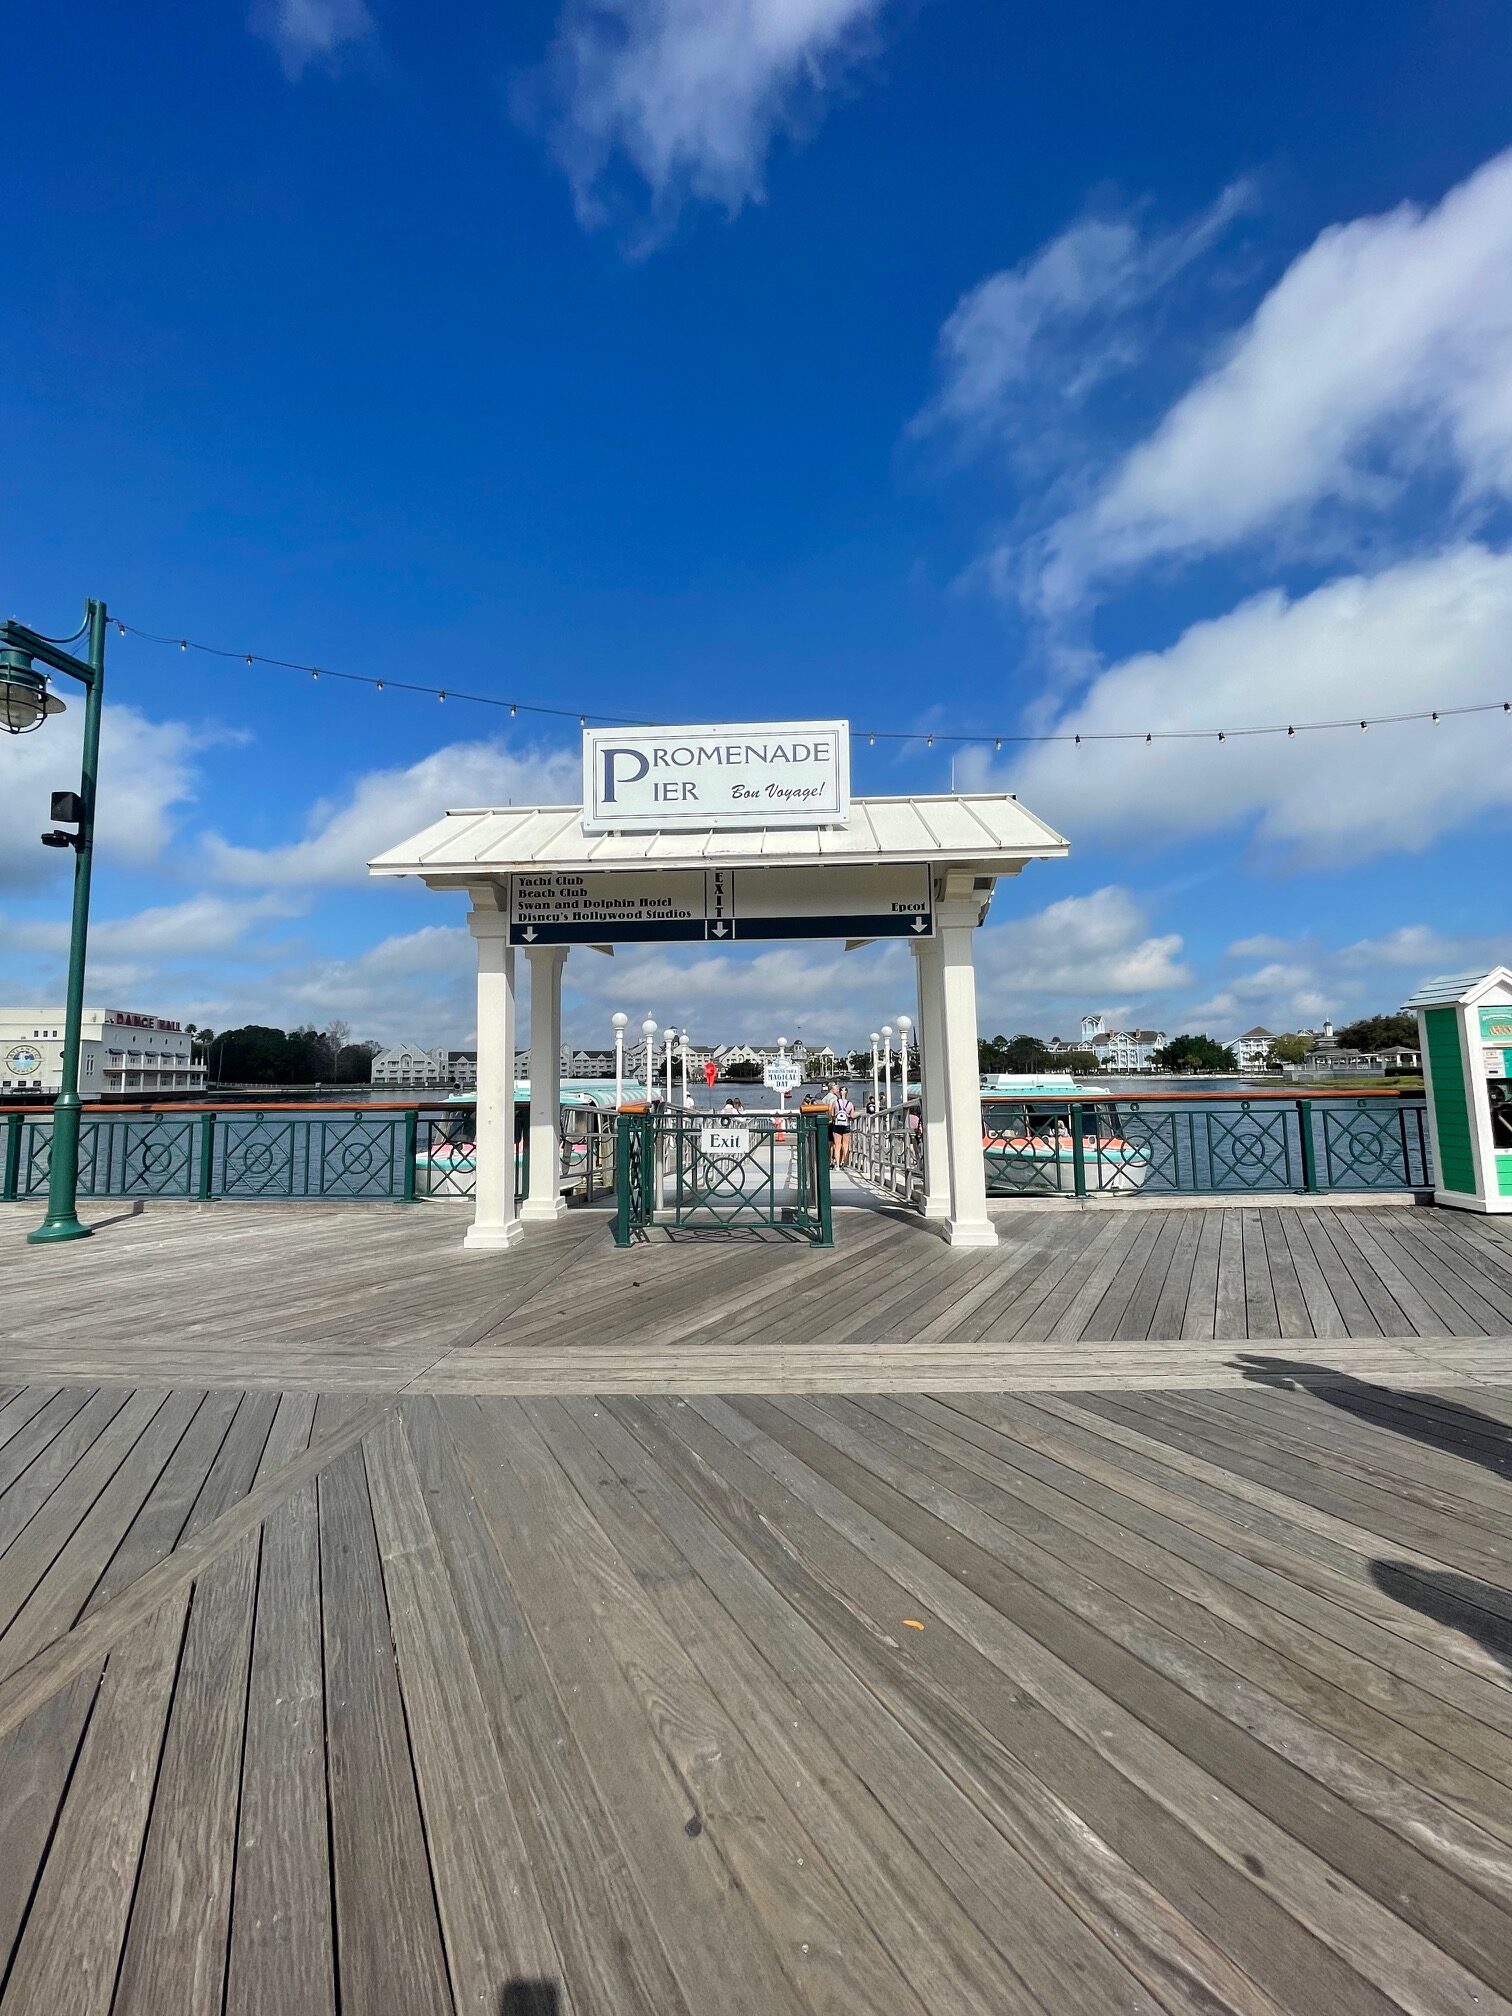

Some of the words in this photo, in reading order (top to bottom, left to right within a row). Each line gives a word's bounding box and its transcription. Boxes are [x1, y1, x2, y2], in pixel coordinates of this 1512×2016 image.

[600, 742, 830, 802] PROMENADE
[731, 784, 760, 799] Bon
[765, 781, 826, 801] Voyage!
[518, 877, 551, 887] Yacht
[556, 876, 584, 886] Club
[518, 889, 555, 899] Beach
[560, 888, 588, 897] Club
[714, 872, 724, 918] EXIT
[518, 901, 549, 910] Swan
[554, 900, 579, 909] and
[583, 898, 635, 909] Dolphin
[639, 897, 672, 907] Hotel
[892, 902, 926, 912] Epcot
[518, 911, 569, 922] Disney's
[573, 910, 642, 921] Hollywood
[646, 908, 692, 919] Studios
[116, 1013, 155, 1029] DANCE
[710, 1133, 740, 1148] Exit
